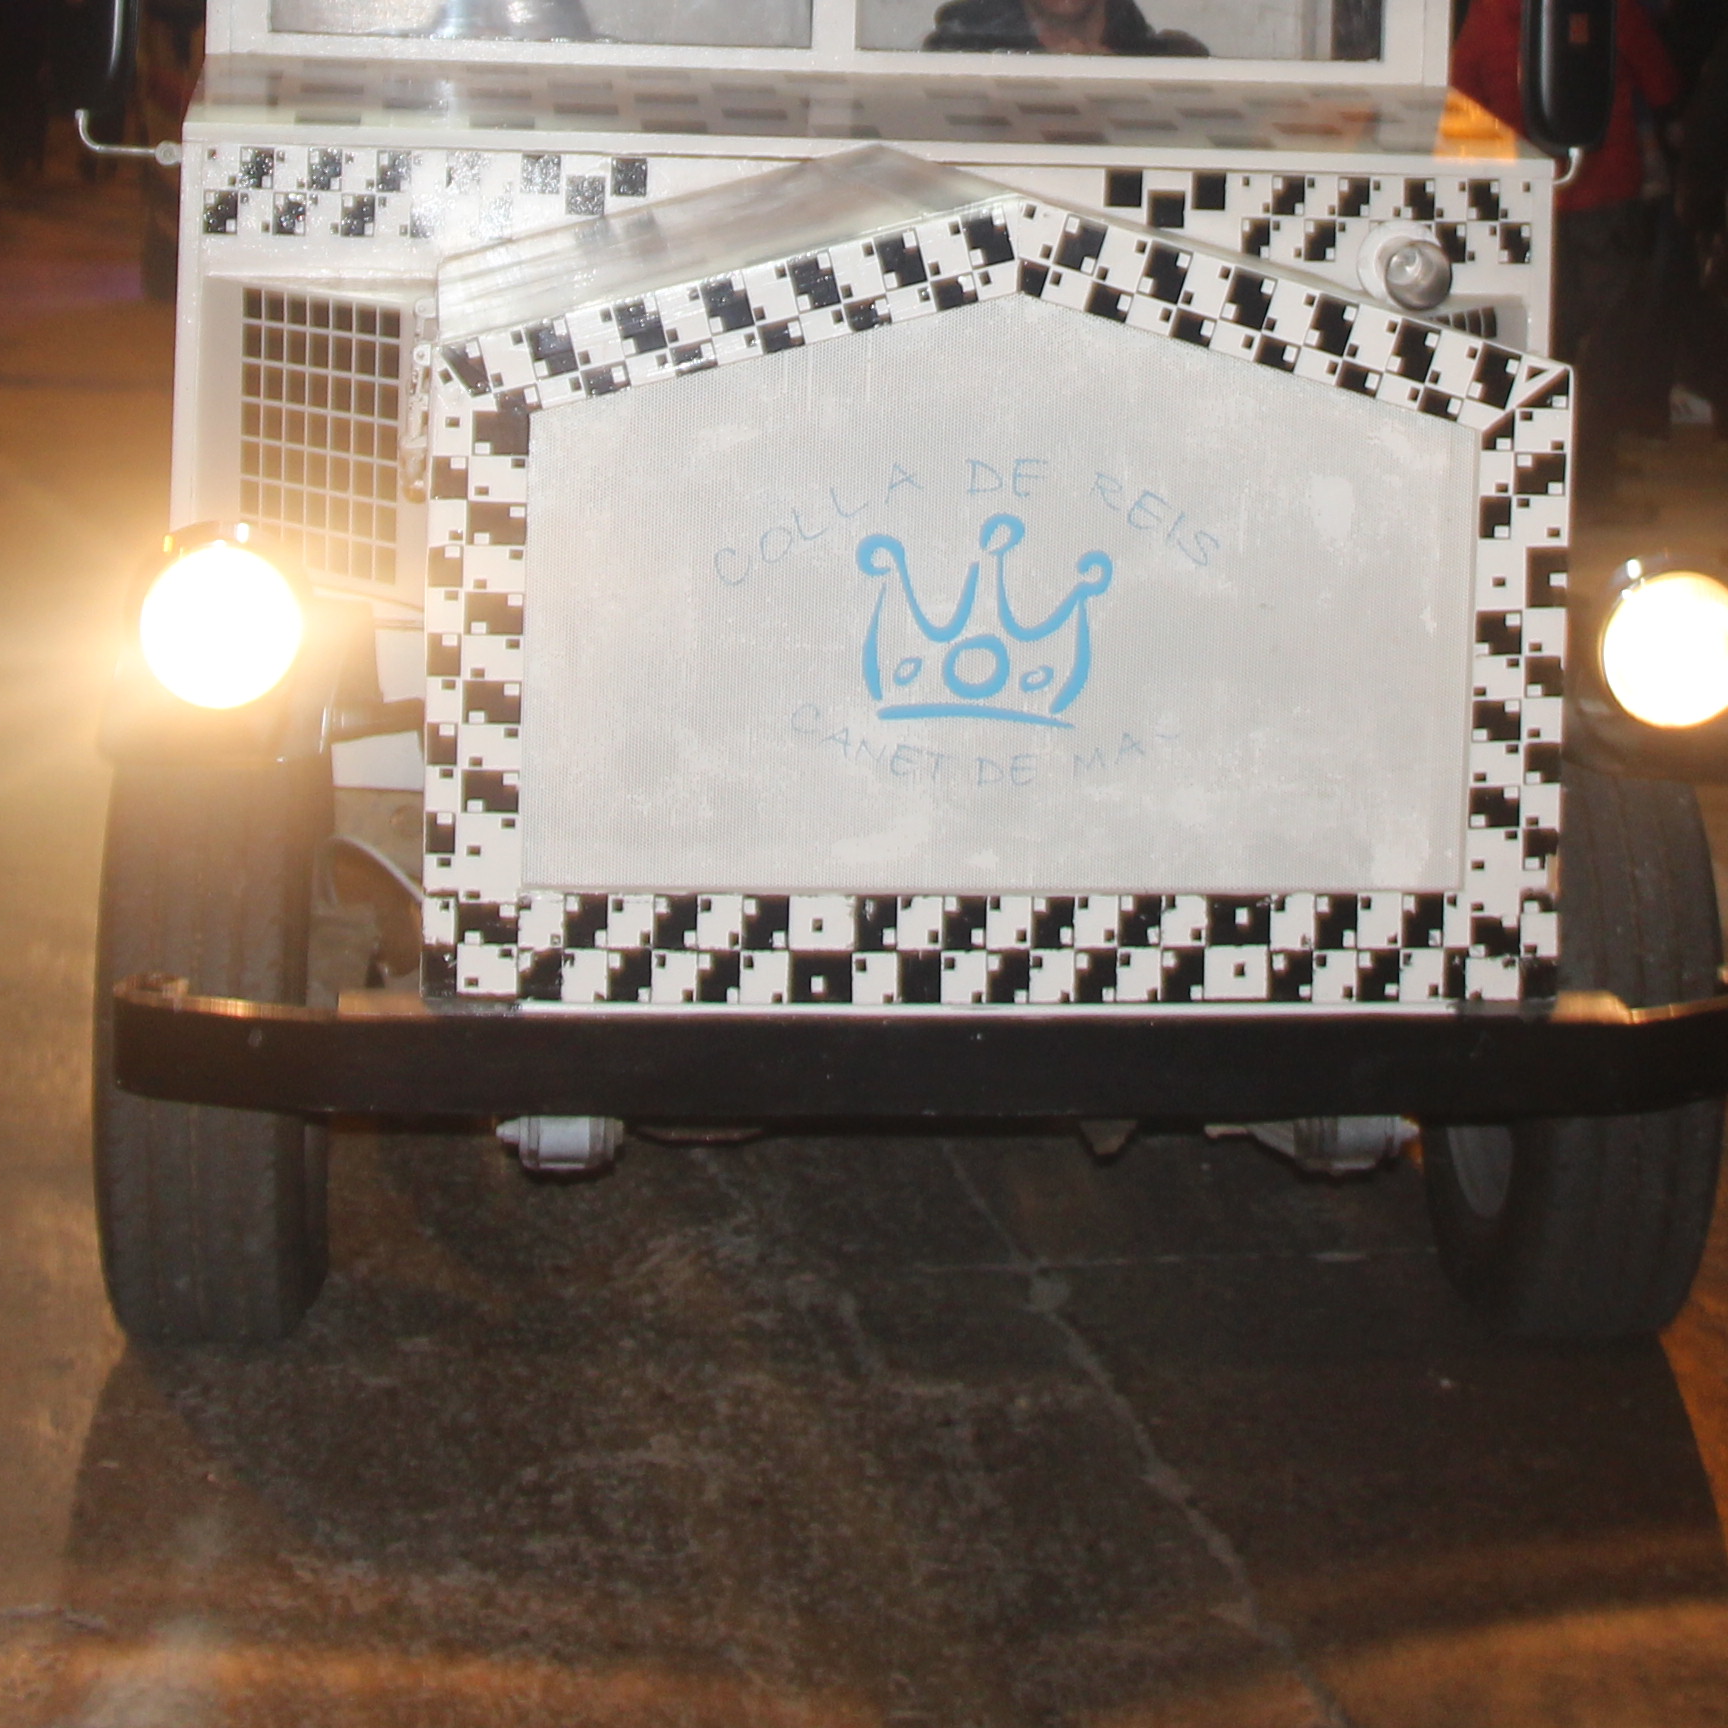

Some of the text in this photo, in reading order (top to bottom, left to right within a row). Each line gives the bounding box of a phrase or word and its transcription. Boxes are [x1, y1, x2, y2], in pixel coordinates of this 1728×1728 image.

[714, 458, 1222, 586] COLLA DE REIS
[790, 703, 954, 785] CANET
[976, 754, 1039, 787] DE
